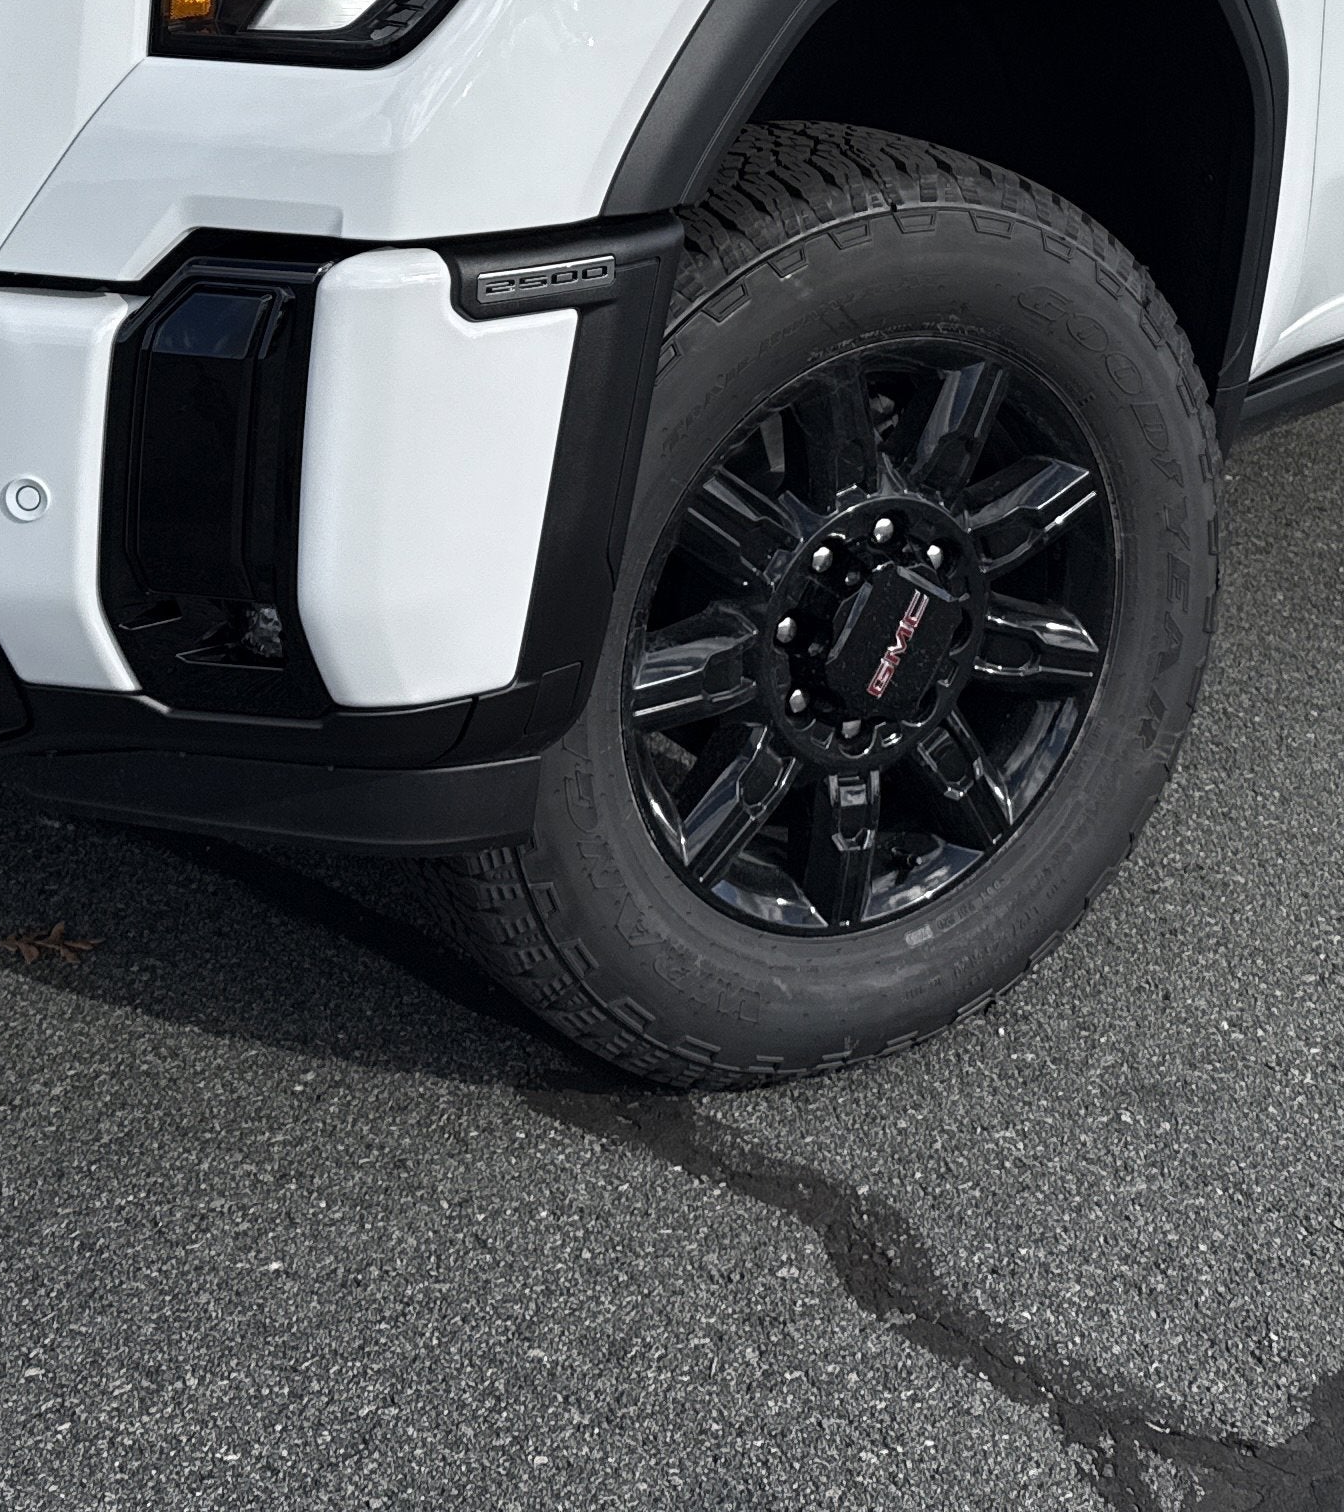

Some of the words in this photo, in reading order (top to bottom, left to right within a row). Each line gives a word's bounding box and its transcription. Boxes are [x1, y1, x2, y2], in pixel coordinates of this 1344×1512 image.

[485, 265, 609, 295] 2500
[1017, 293, 1192, 751] GOODYEAR
[866, 589, 929, 698] GMC
